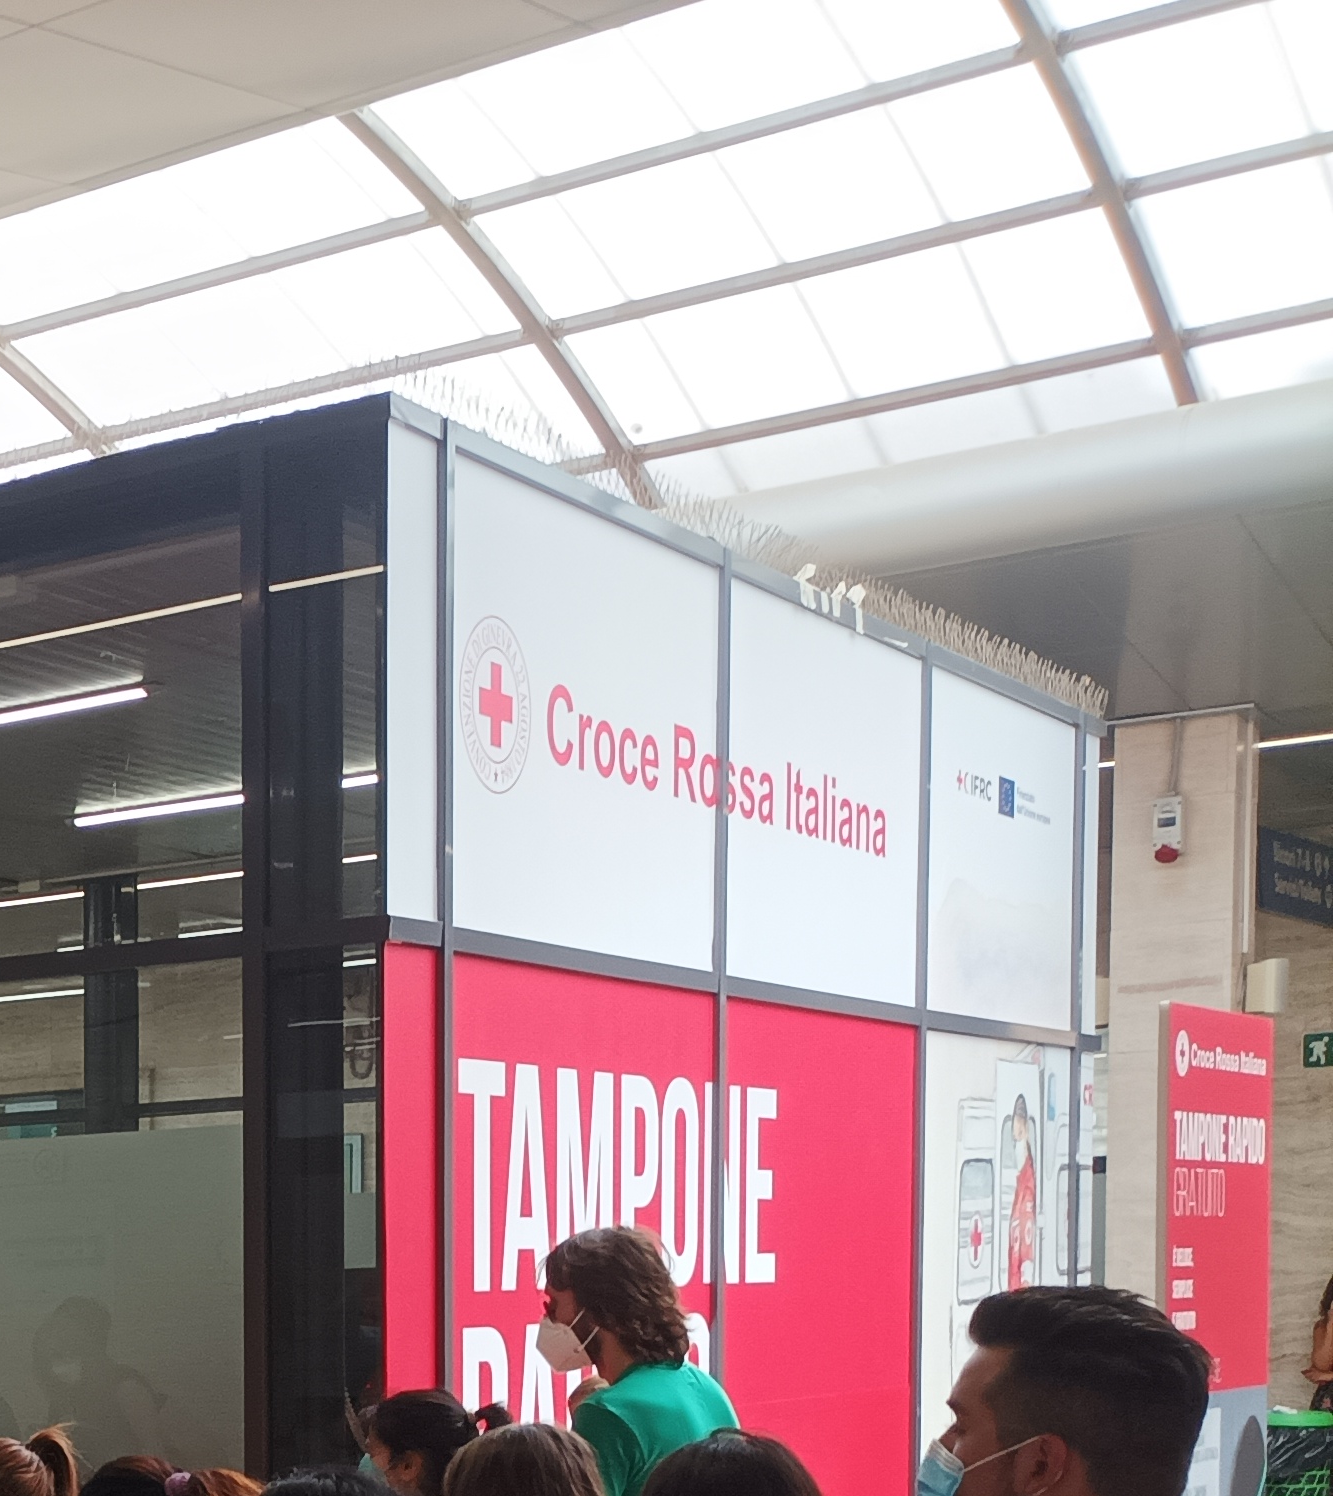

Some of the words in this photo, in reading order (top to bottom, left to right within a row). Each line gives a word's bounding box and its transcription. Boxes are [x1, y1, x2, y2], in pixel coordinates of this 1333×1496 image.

[546, 684, 660, 792] Croce
[673, 723, 774, 826] Rossa
[786, 762, 887, 859] Italiana
[970, 774, 992, 802] IFRC
[1190, 1042, 1215, 1069] Croce
[1215, 1046, 1240, 1073] Rossa
[1173, 1110, 1227, 1163] TAMPONE
[1227, 1115, 1266, 1165] RAPIDO
[457, 1057, 778, 1293] TAMPONE
